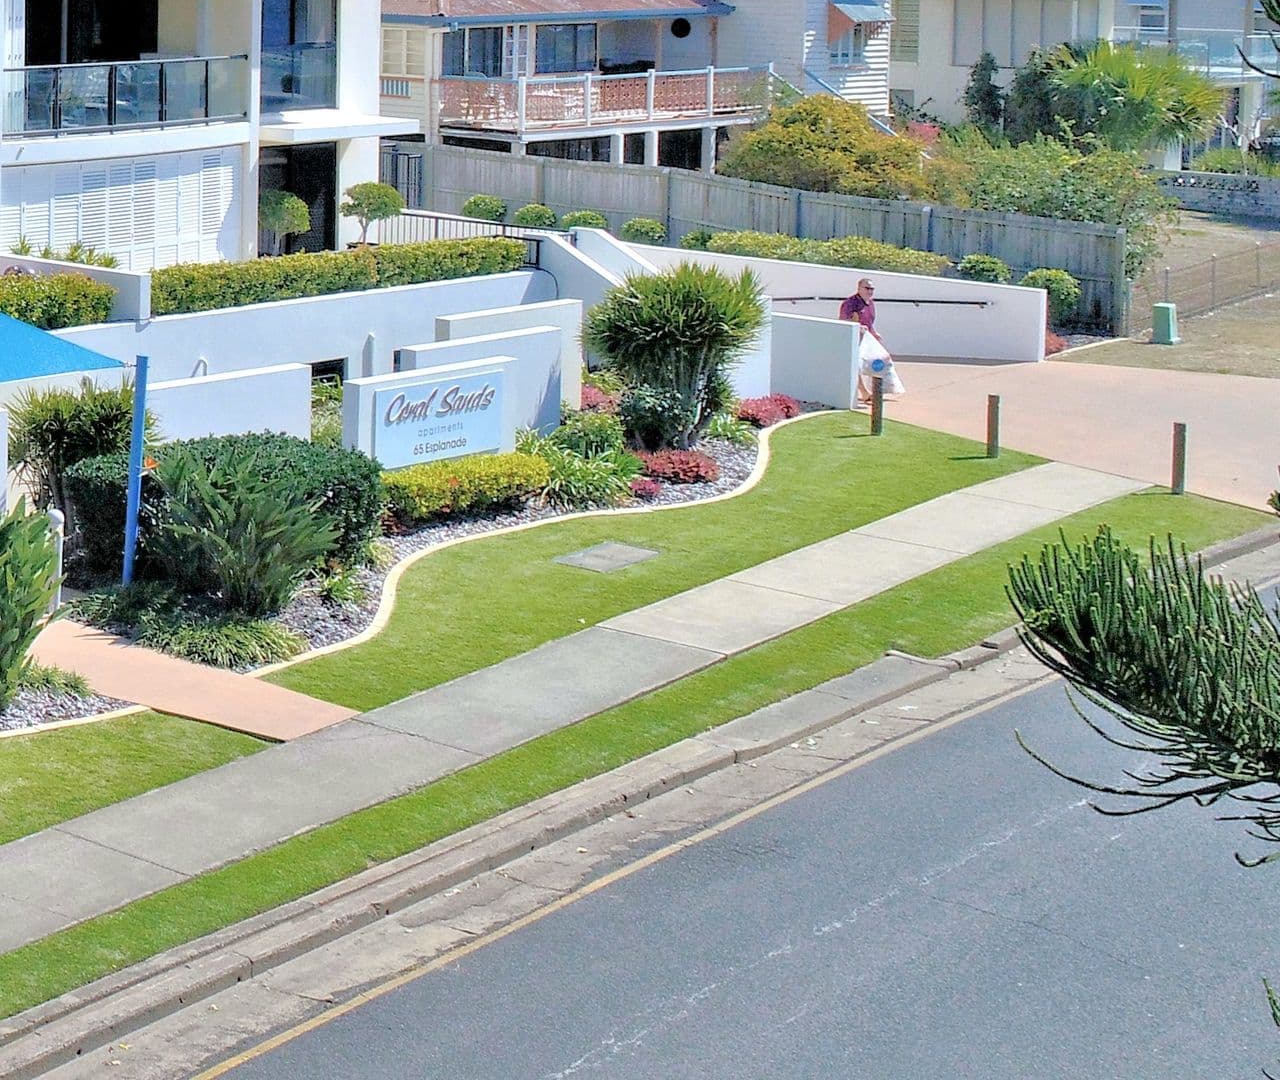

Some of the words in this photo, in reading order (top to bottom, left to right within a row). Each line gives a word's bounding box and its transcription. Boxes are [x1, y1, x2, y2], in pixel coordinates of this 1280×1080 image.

[384, 387, 438, 427] Coral
[435, 383, 495, 417] Sands
[418, 422, 463, 437] apartments
[413, 443, 424, 456] 65
[425, 437, 466, 453] Esplanade
